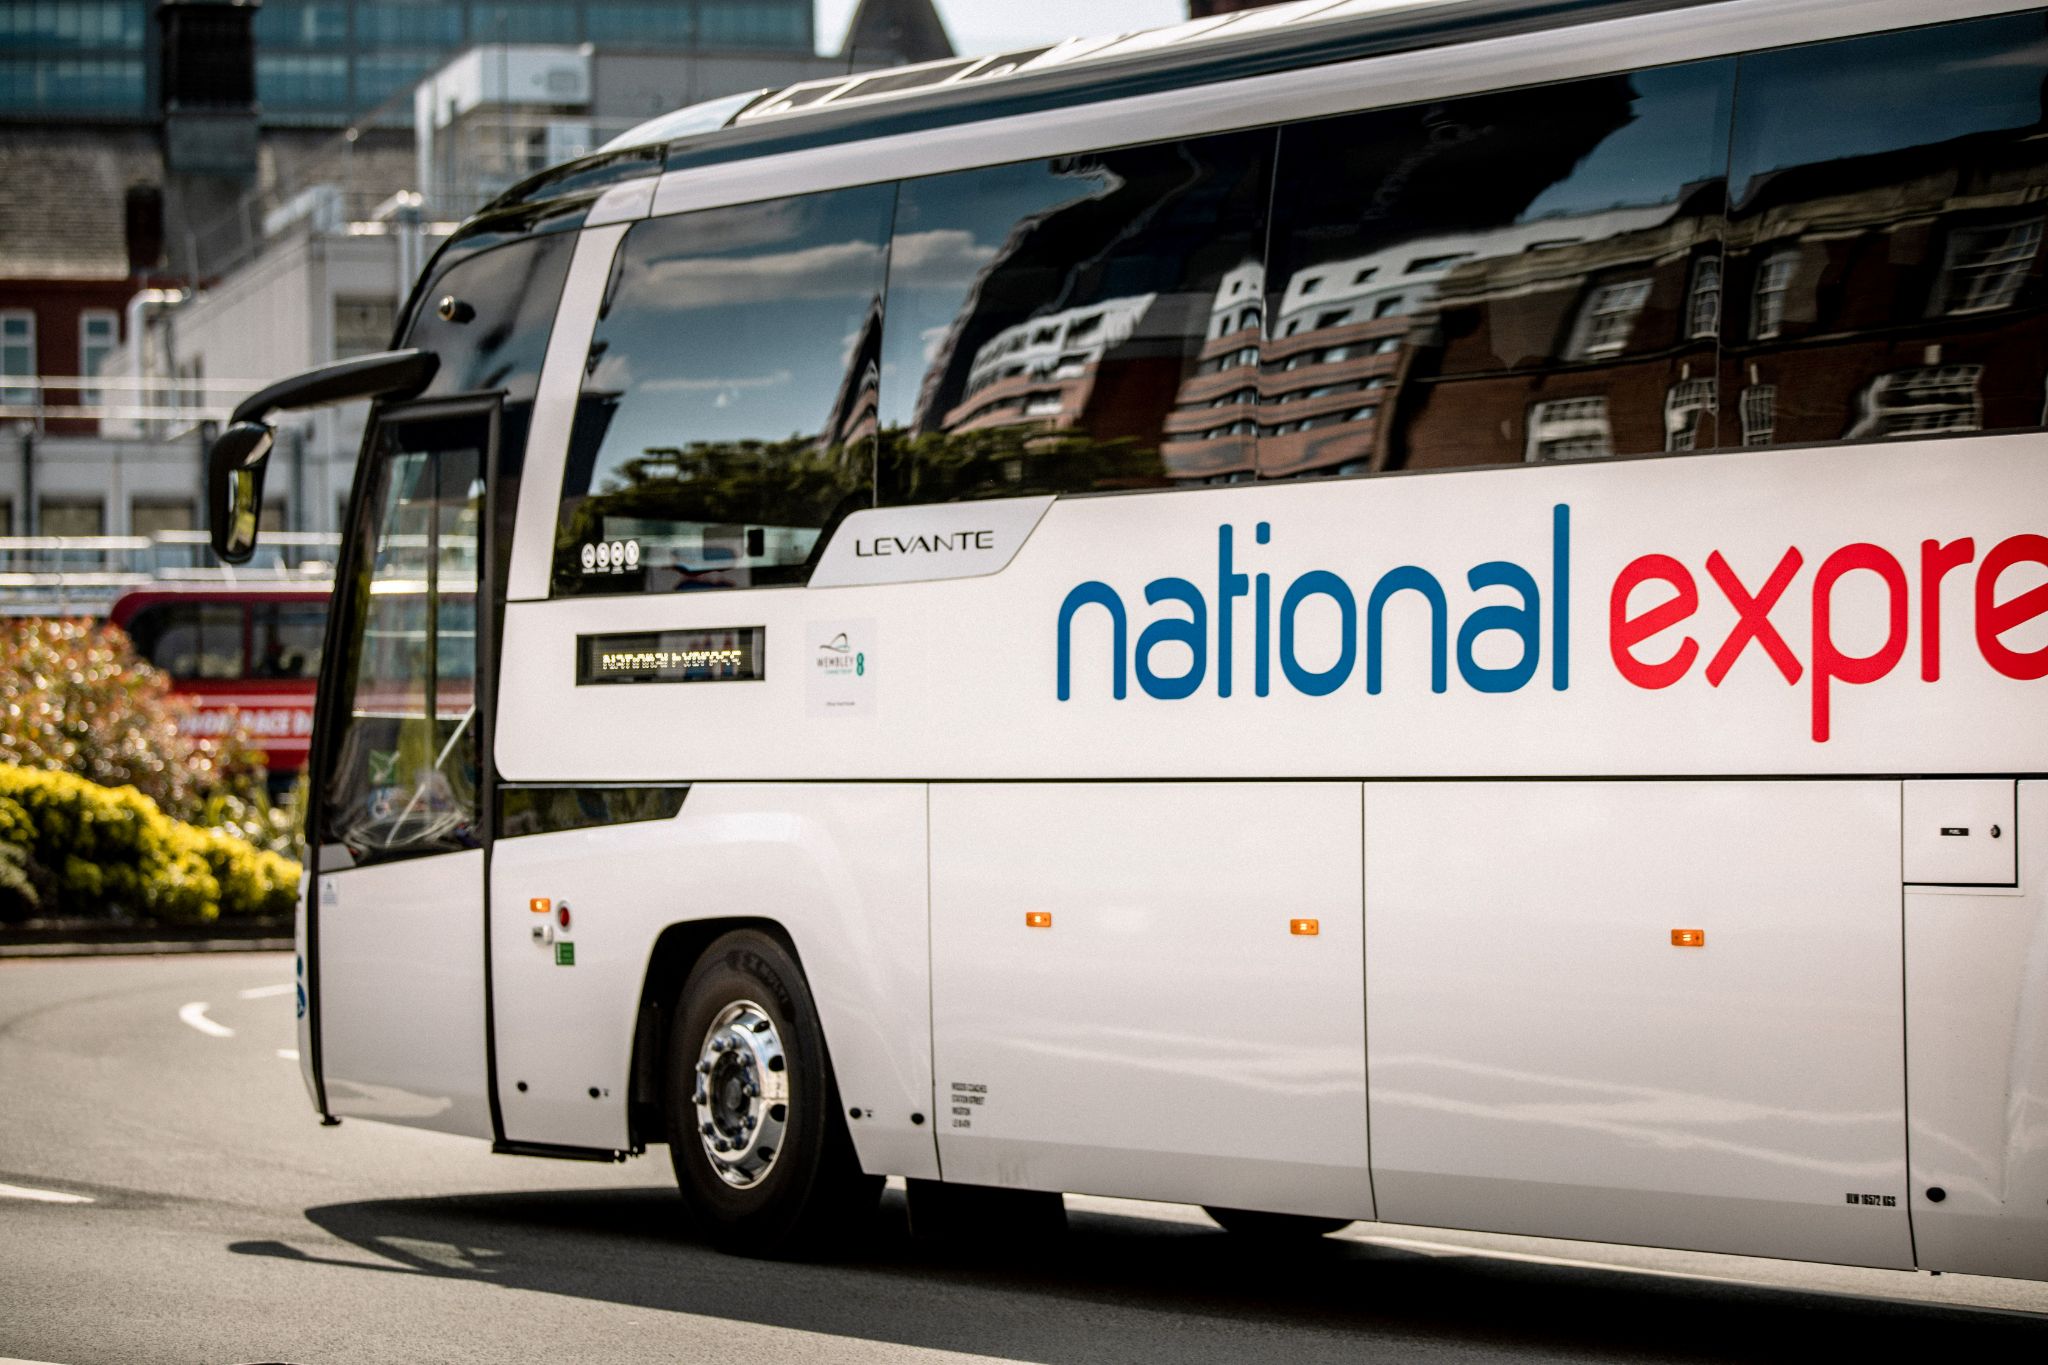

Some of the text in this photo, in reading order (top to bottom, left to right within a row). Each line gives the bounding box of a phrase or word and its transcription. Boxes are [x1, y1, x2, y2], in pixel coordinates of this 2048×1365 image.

[855, 529, 995, 558] LEVANTE
[1057, 502, 2048, 743] national expre
[816, 656, 854, 668] WEMBLEY
[856, 652, 865, 677] 8
[1861, 1193, 1881, 1206] 16572
[1882, 1195, 1896, 1207] KGS
